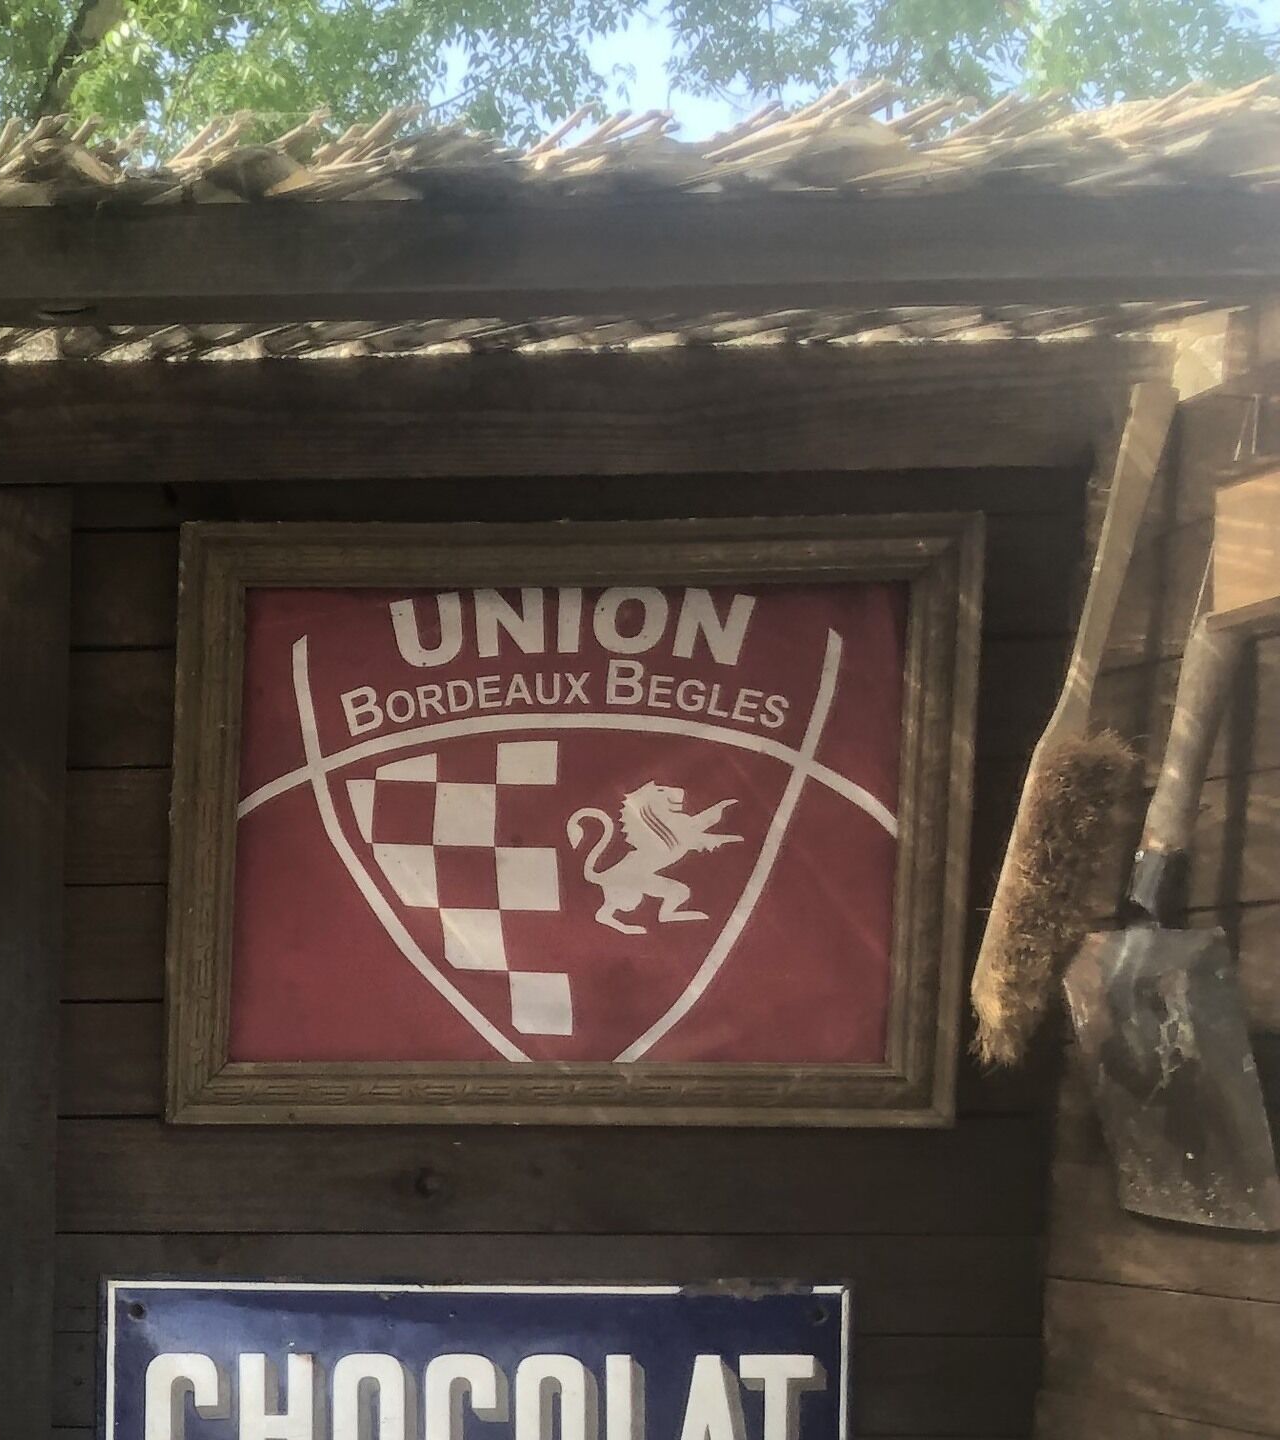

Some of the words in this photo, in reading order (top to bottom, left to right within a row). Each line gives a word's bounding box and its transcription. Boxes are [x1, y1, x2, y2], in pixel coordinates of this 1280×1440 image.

[388, 587, 756, 667] UNION
[340, 671, 591, 738] BORDEAUX
[606, 658, 790, 729] BEGLES
